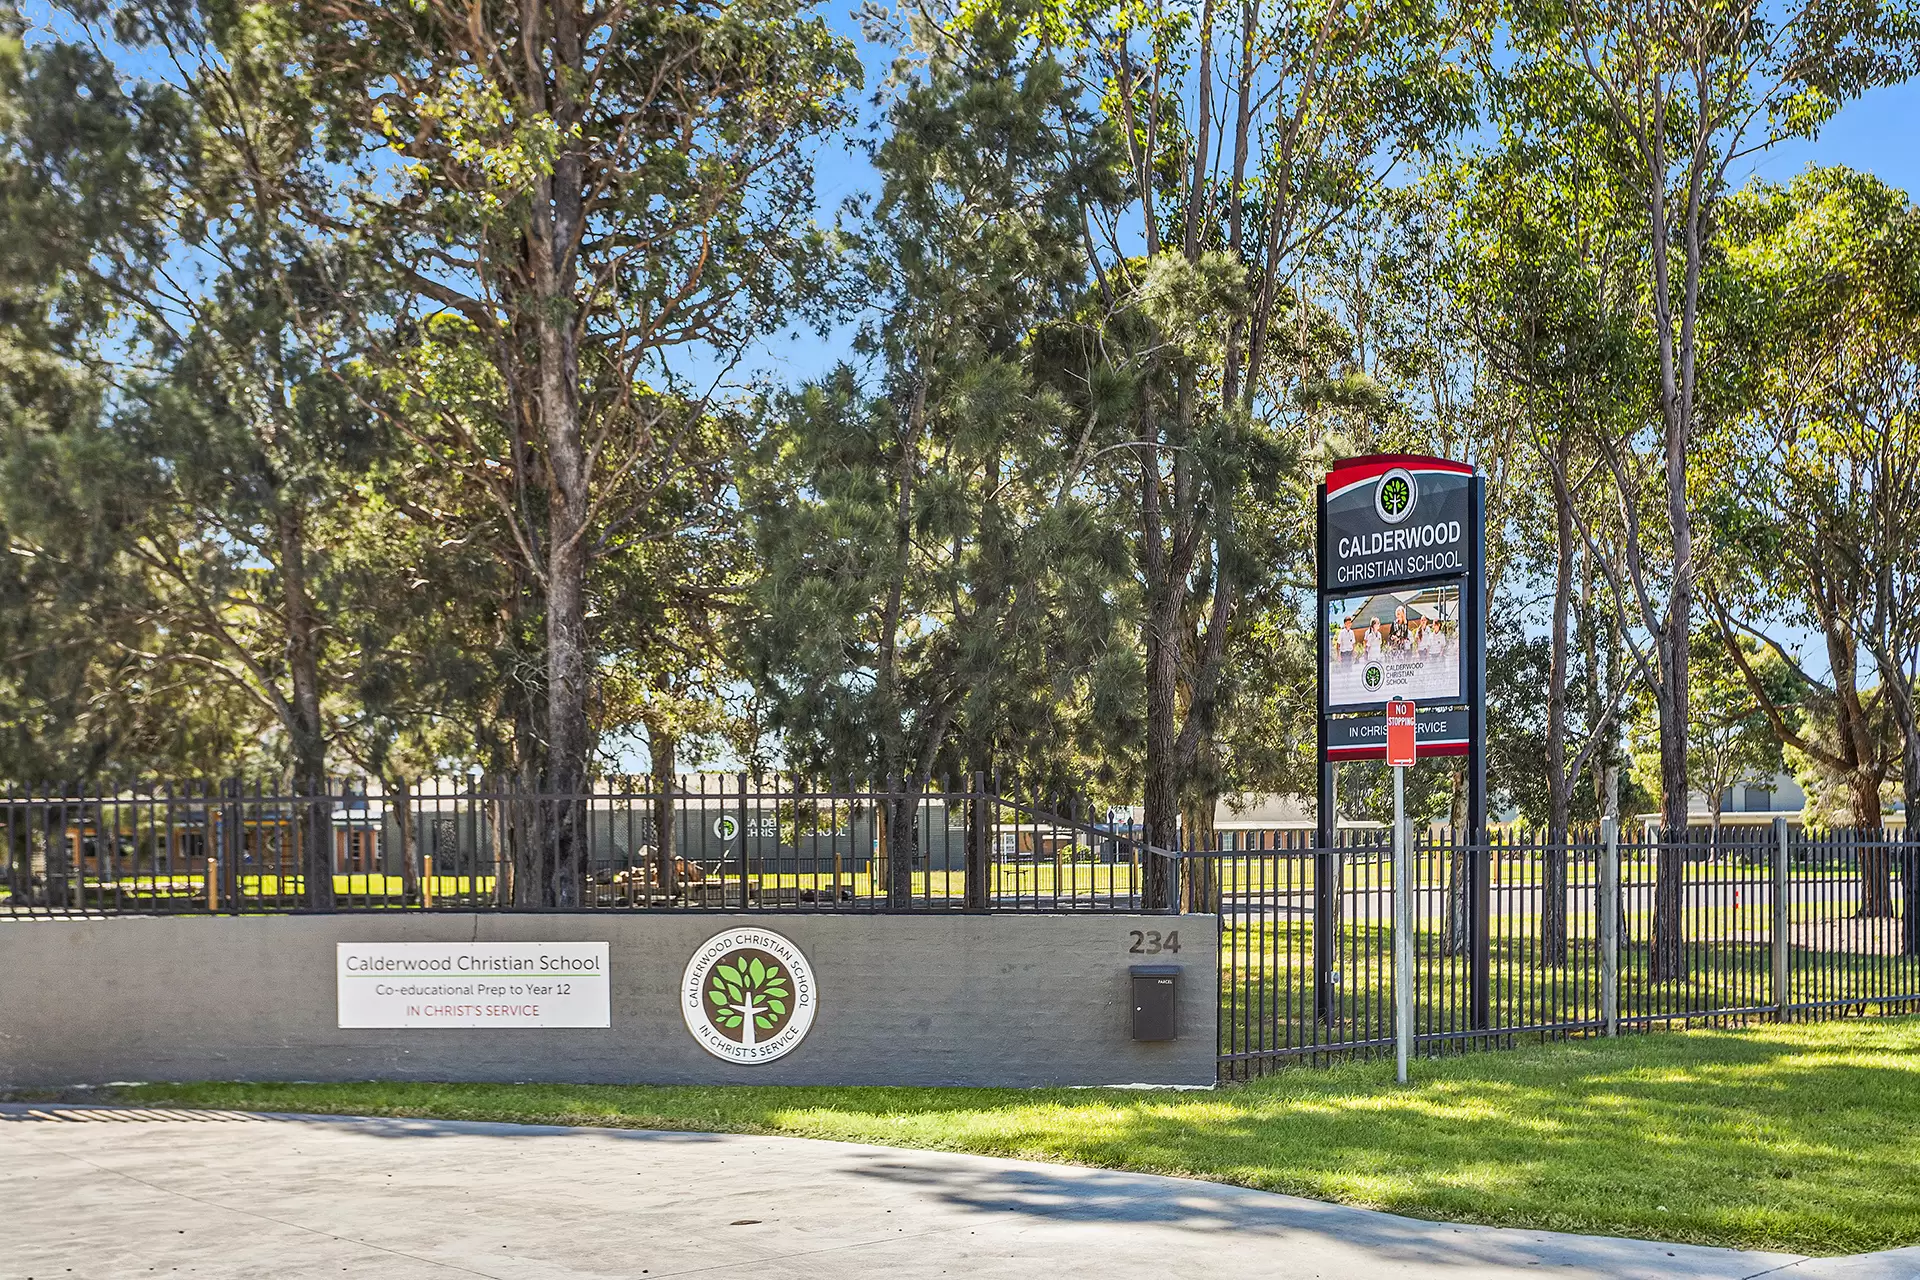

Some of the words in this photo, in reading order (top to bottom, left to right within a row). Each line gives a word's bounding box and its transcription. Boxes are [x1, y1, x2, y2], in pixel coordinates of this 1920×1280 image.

[1338, 521, 1461, 558] CALDERWOOD
[1337, 558, 1403, 583] CHRISTIAN
[1407, 550, 1463, 574] SCHOOL
[1386, 662, 1424, 672] CALDERWOOD
[1386, 671, 1414, 679] CHRISTIAN
[1386, 678, 1408, 686] SCHOOL
[1395, 704, 1407, 715] NO
[1388, 716, 1415, 726] STOPPING
[1349, 727, 1359, 738] IN
[1415, 721, 1447, 734] ERVICE
[1129, 930, 1181, 954] 234
[346, 955, 452, 972] Calderwood
[457, 955, 534, 971] Christian
[539, 955, 600, 971] School
[689, 938, 733, 1008] CALDERWOOD
[735, 935, 793, 961] CHRISTIAN
[790, 960, 809, 1009] SCHOOL
[375, 984, 474, 996] Co-educational
[477, 984, 507, 998] Prep
[510, 985, 523, 996] to
[525, 984, 553, 996] Year
[557, 984, 571, 995] 12
[407, 1005, 421, 1017] IN
[424, 1005, 483, 1017] CHRIST'S
[486, 1005, 540, 1017] SERVICE
[699, 1024, 711, 1038] IN
[710, 1036, 757, 1058] CHRIST'S
[760, 1025, 799, 1057] SERVICE
